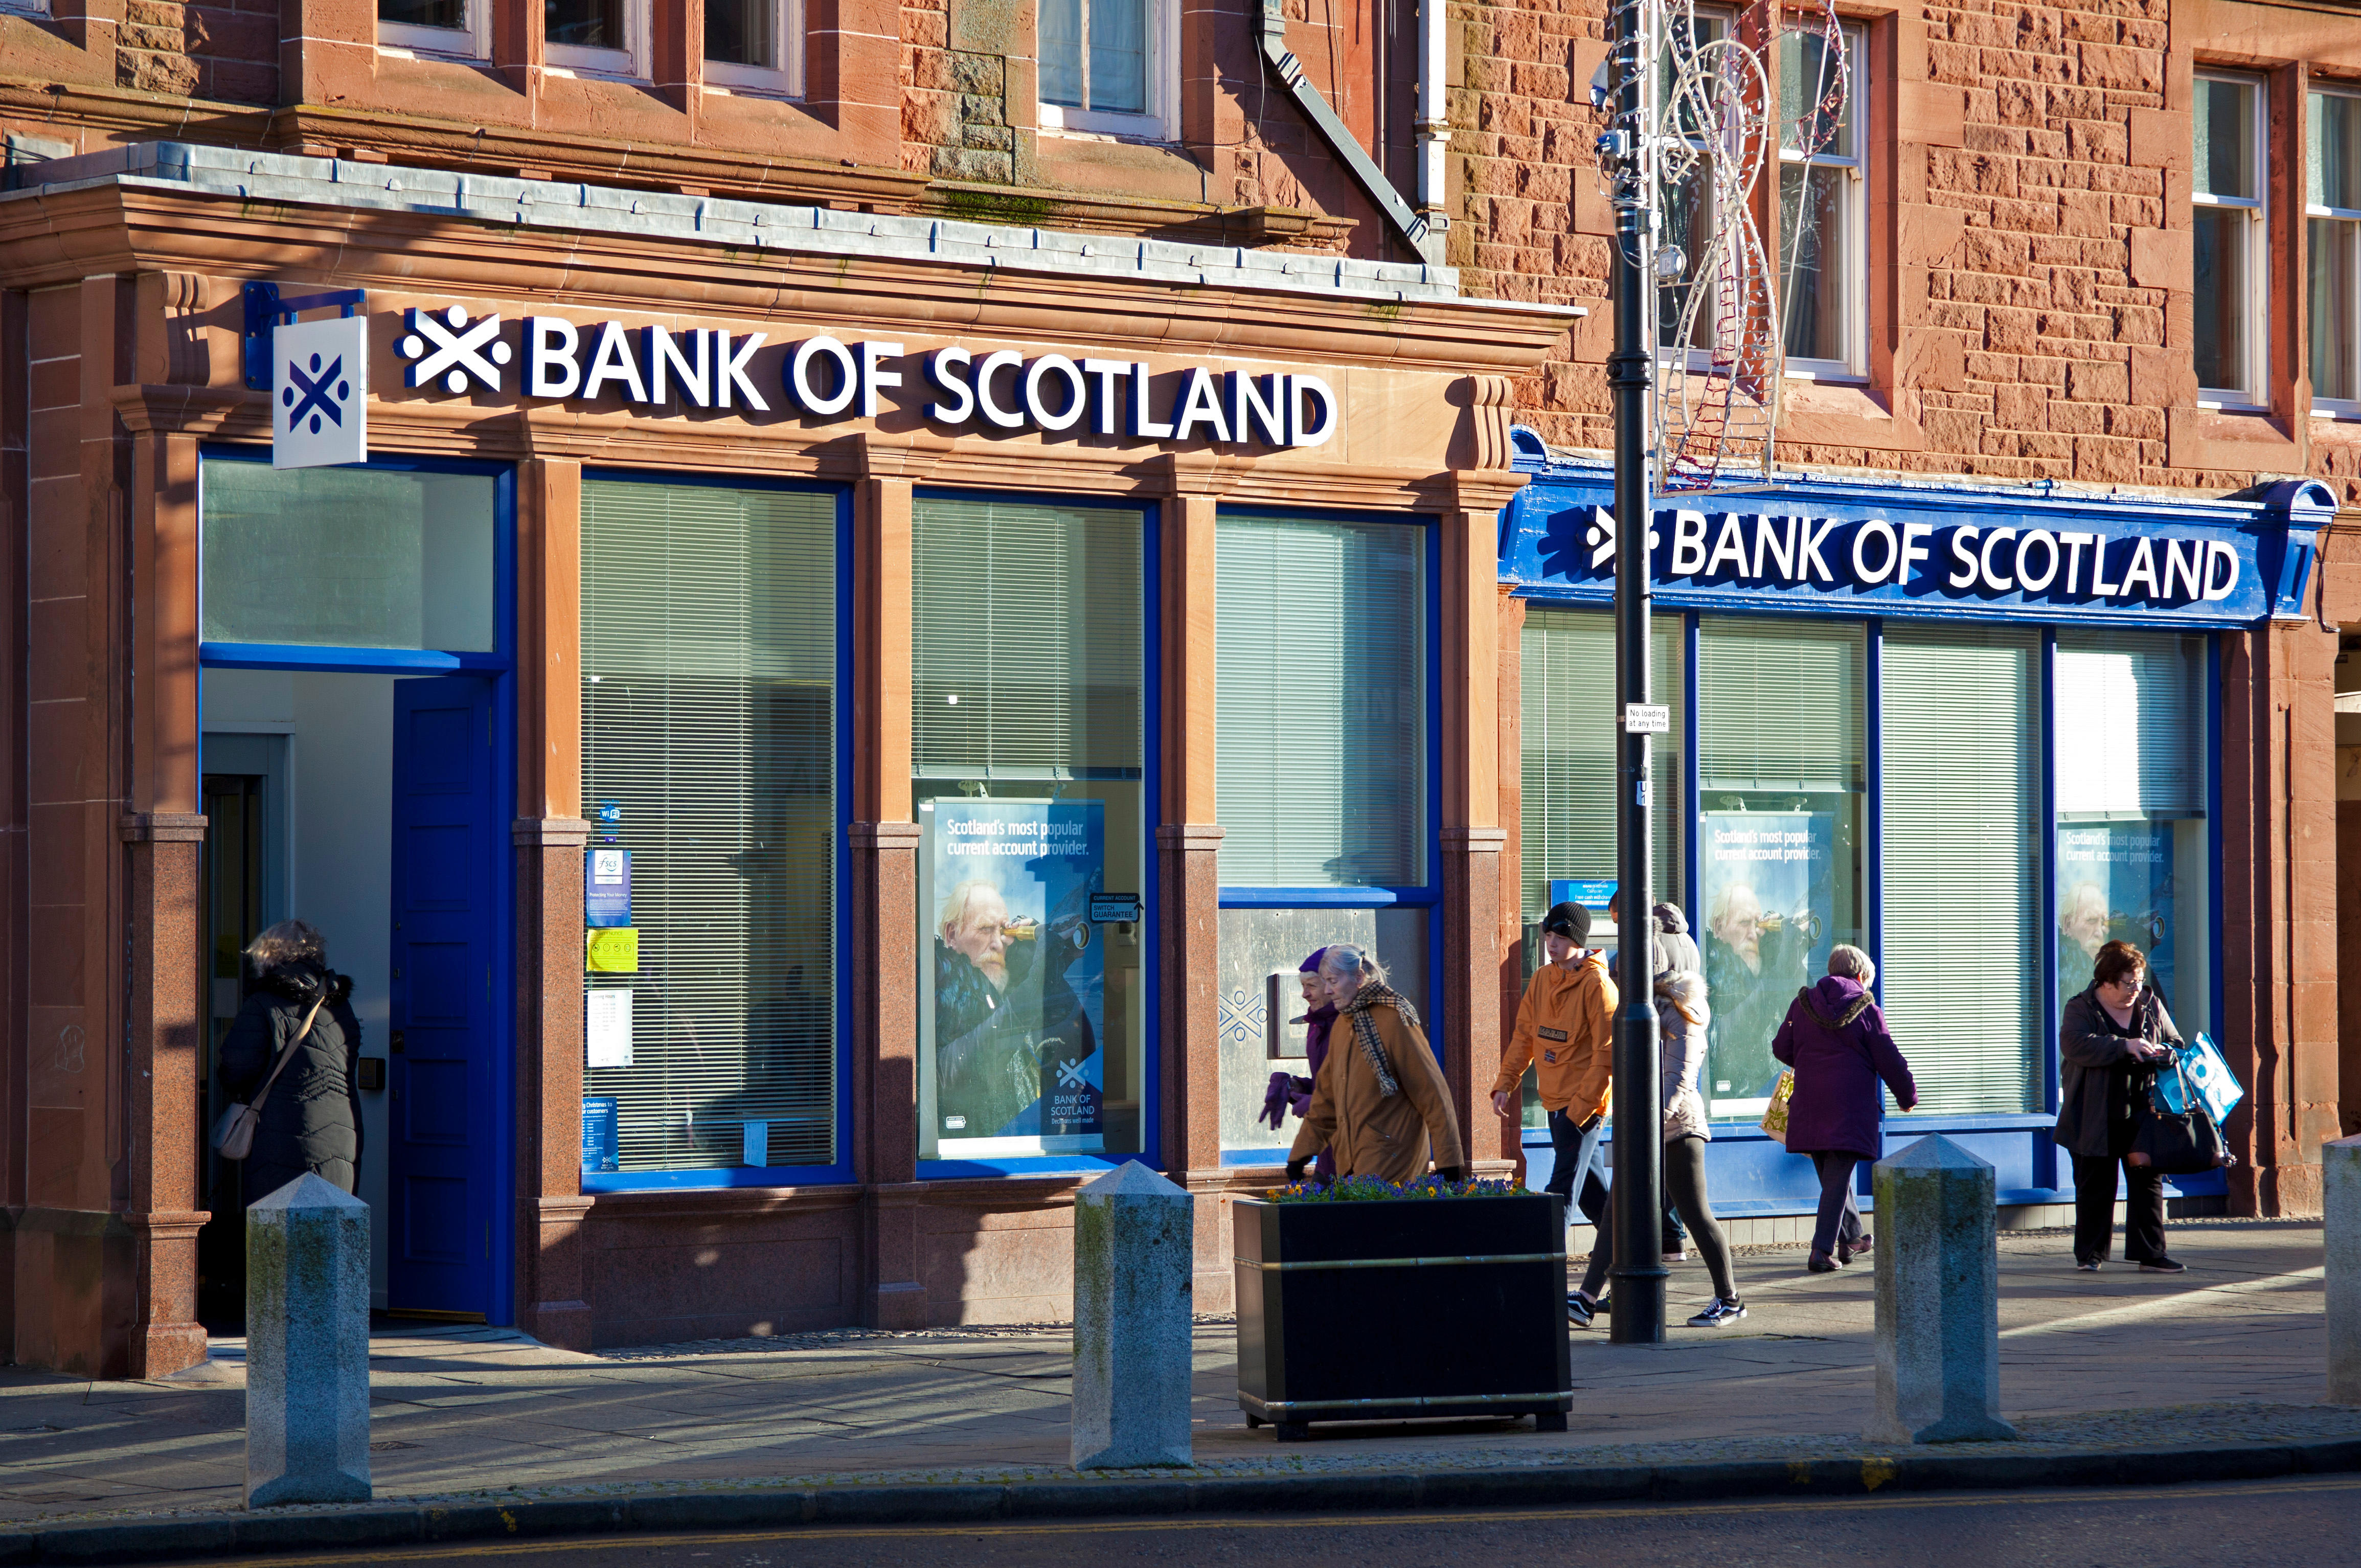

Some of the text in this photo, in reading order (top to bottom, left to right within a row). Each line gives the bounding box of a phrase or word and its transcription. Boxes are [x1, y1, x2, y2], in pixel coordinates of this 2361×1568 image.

[529, 315, 1338, 448] BANK OF SCOTLAND
[1670, 508, 2240, 601] BANK OF SCOTLAND
[1642, 709, 1666, 719] loading
[1640, 782, 1647, 792] U
[947, 819, 1083, 840] Scotland's most popular
[1714, 829, 1817, 847] Scotland's most popular
[947, 840, 1089, 859] current account provider.
[2066, 831, 2160, 850] Scotland's most popular
[1715, 846, 1821, 864] current account provider.
[2066, 850, 2164, 866] current account provider.
[1054, 1094, 1091, 1104] BANK OF
[1051, 1106, 1095, 1116] SCOTLAND
